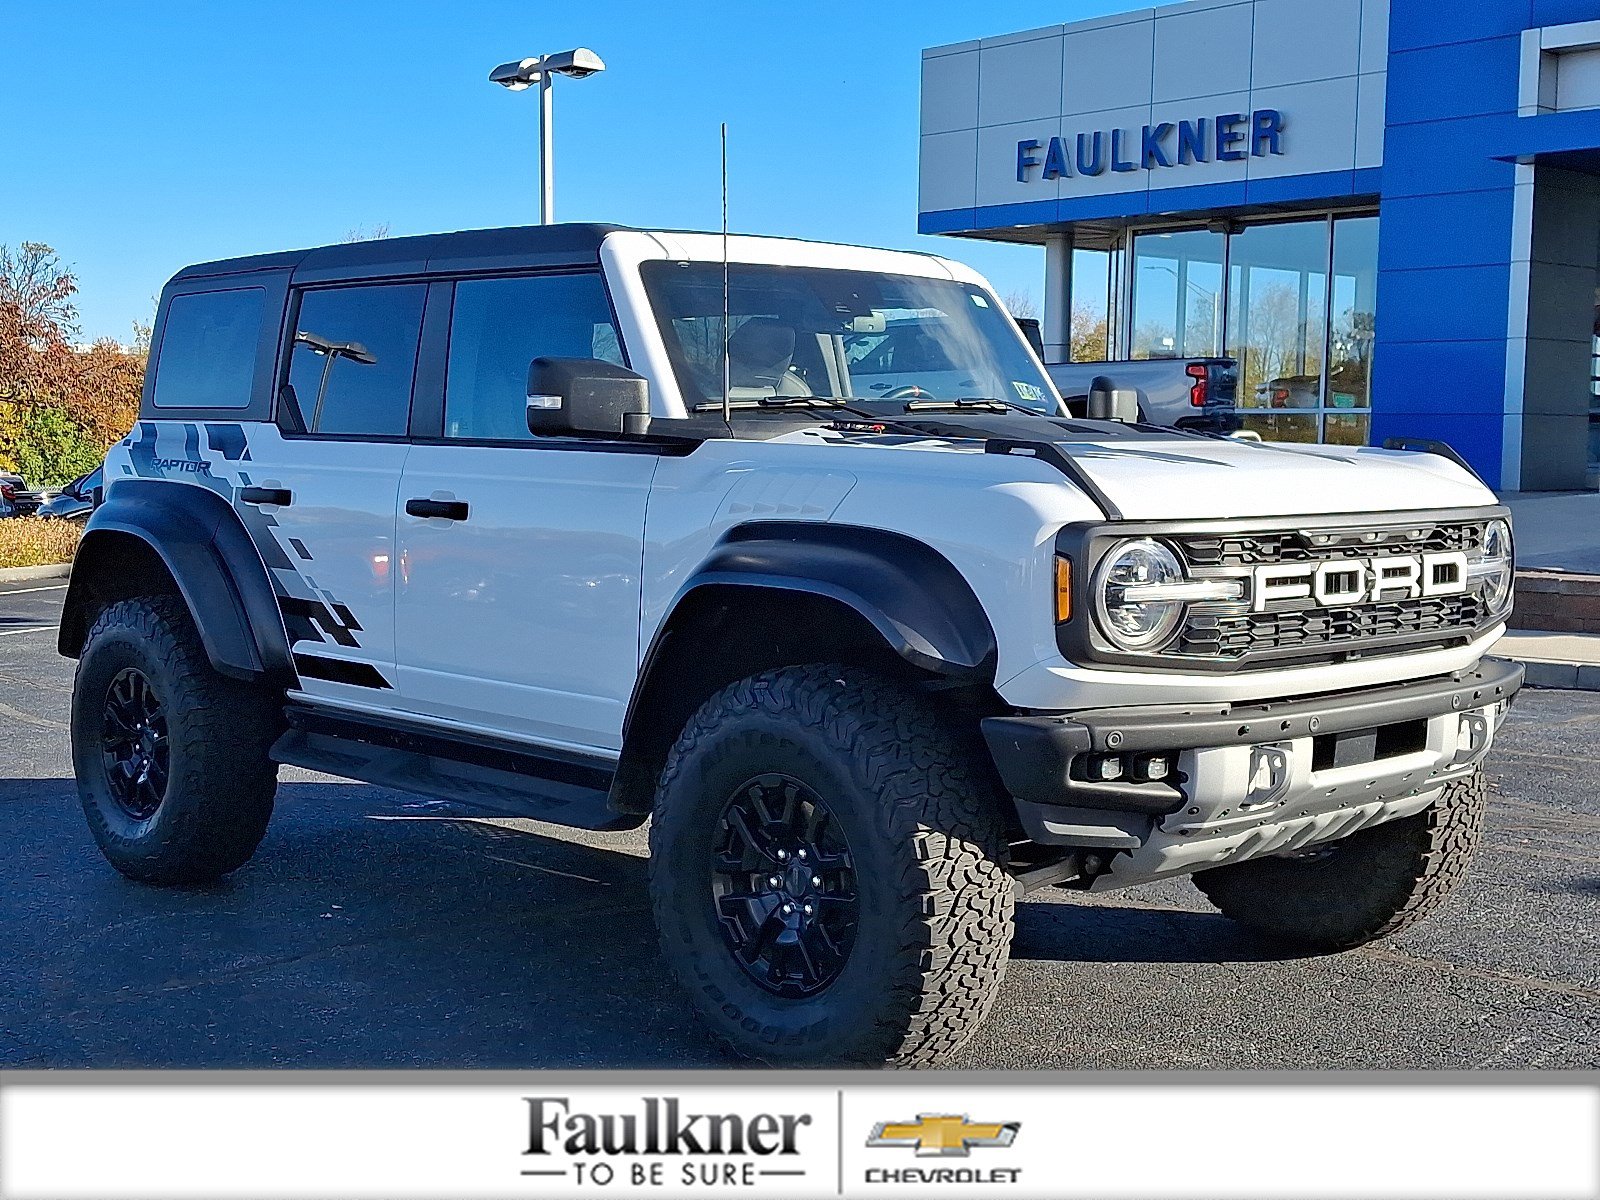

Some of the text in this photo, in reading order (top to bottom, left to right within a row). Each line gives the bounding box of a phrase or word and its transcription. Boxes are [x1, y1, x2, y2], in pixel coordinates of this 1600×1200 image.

[1016, 109, 1285, 183] FAULKNER
[149, 458, 212, 478] RAPTOR
[1254, 551, 1468, 612] FORD
